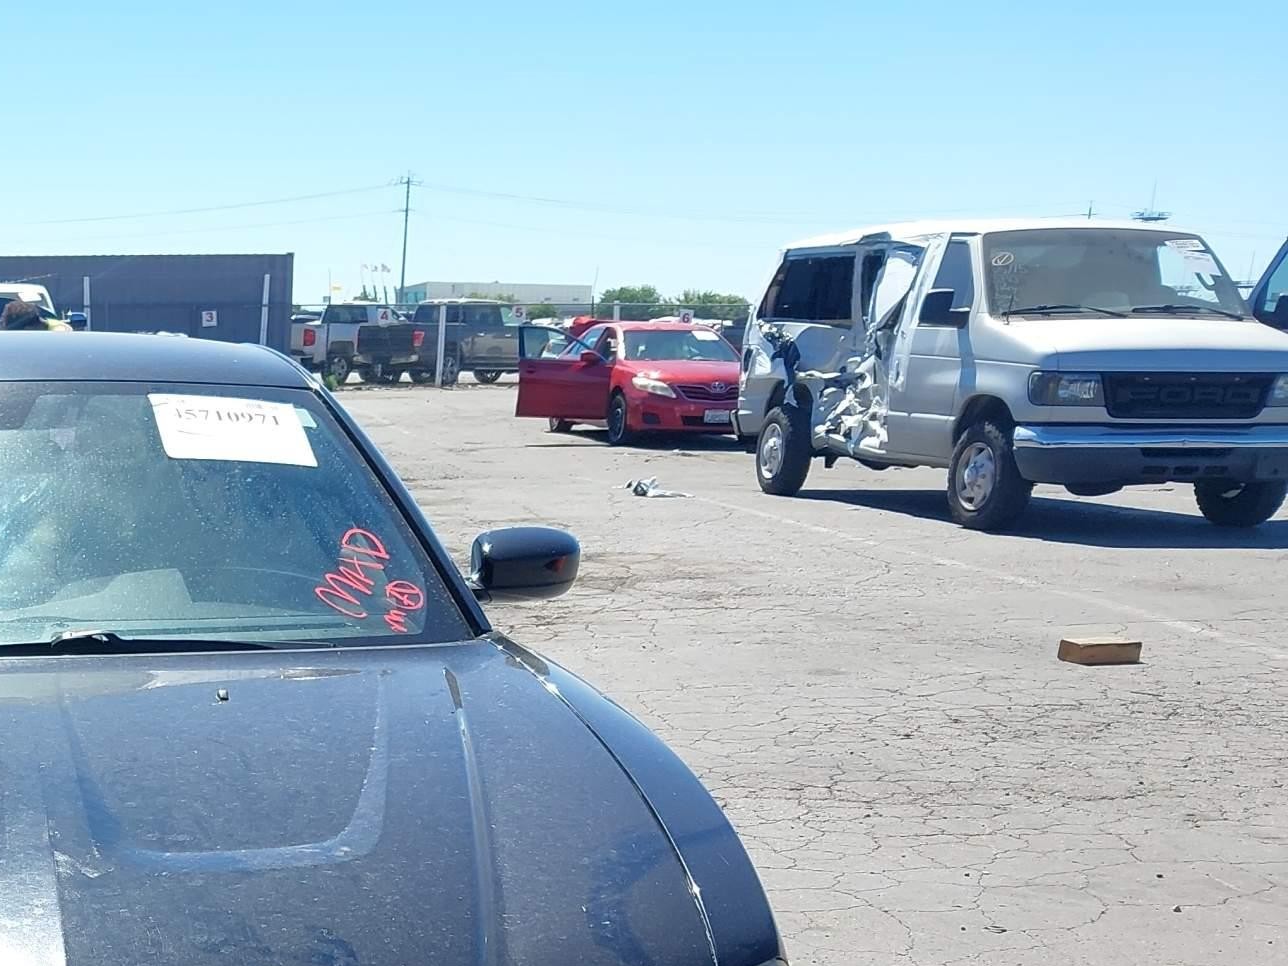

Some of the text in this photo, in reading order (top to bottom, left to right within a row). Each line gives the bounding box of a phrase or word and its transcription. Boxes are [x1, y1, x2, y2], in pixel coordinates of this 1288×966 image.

[205, 312, 214, 323] 3
[380, 309, 390, 321] 4
[514, 307, 524, 318] 5
[682, 312, 691, 323] 6
[1128, 385, 1262, 404] FORD
